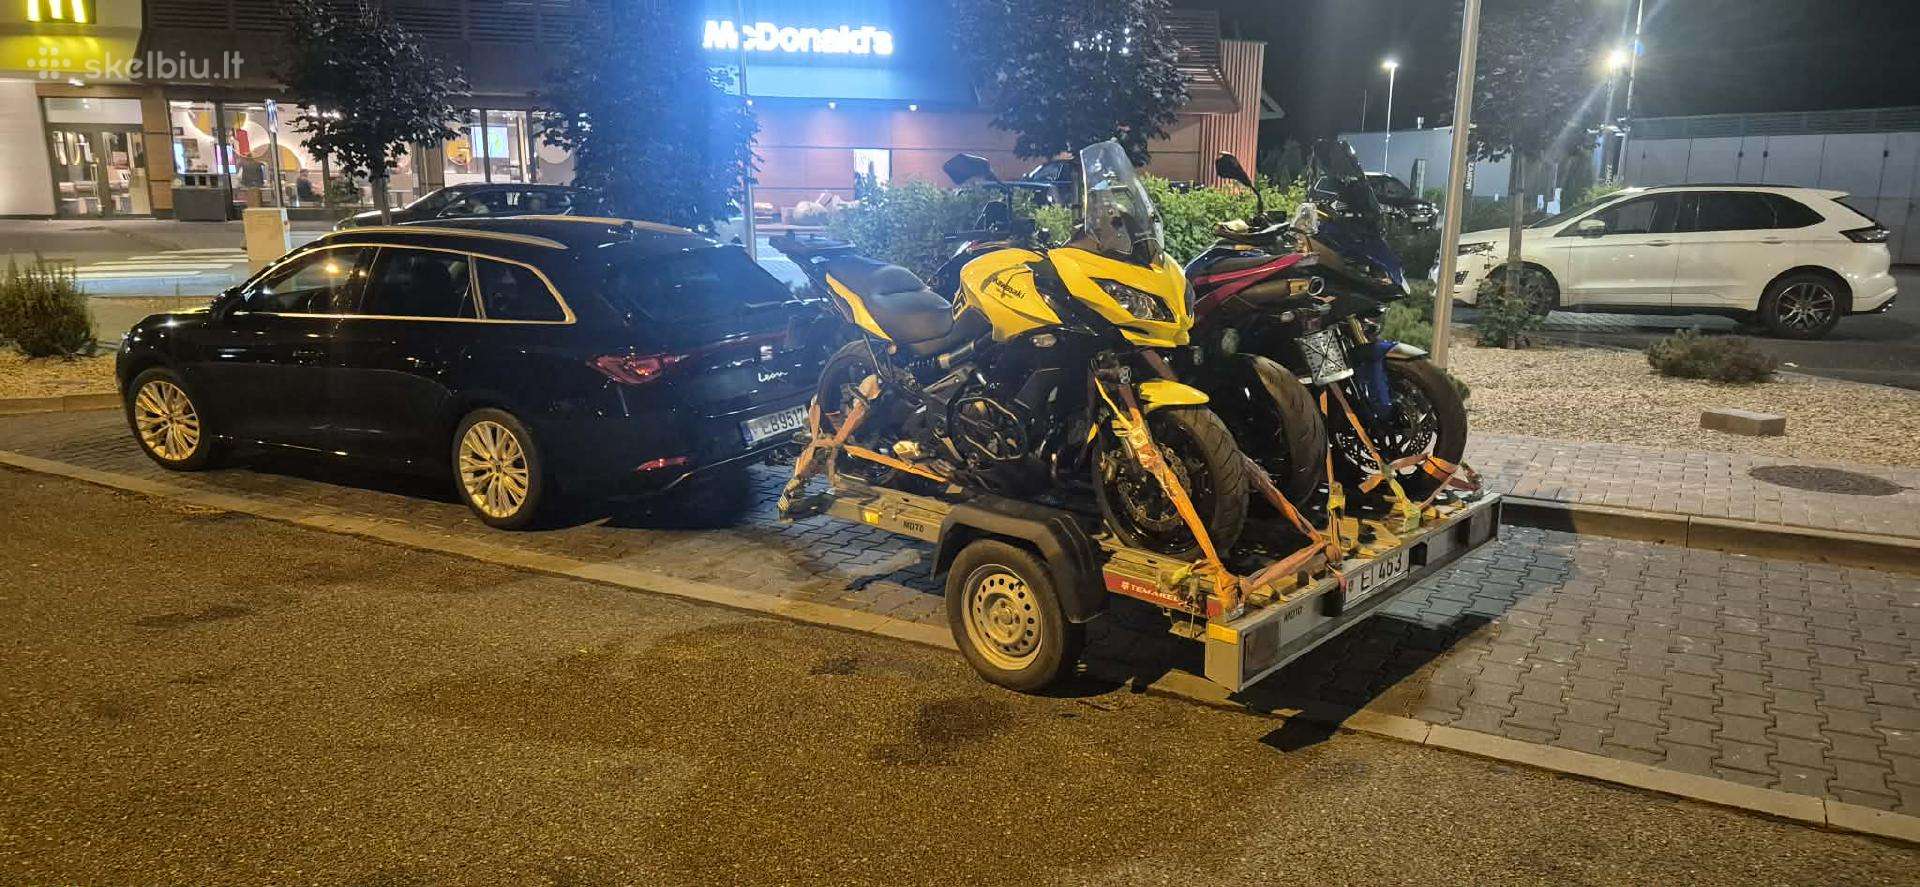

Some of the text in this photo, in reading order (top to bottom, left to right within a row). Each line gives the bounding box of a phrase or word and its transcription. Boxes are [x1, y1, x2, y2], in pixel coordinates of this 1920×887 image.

[703, 20, 893, 55] McDonald's
[993, 277, 1026, 299] Kawasaki
[1379, 551, 1402, 579] 463
